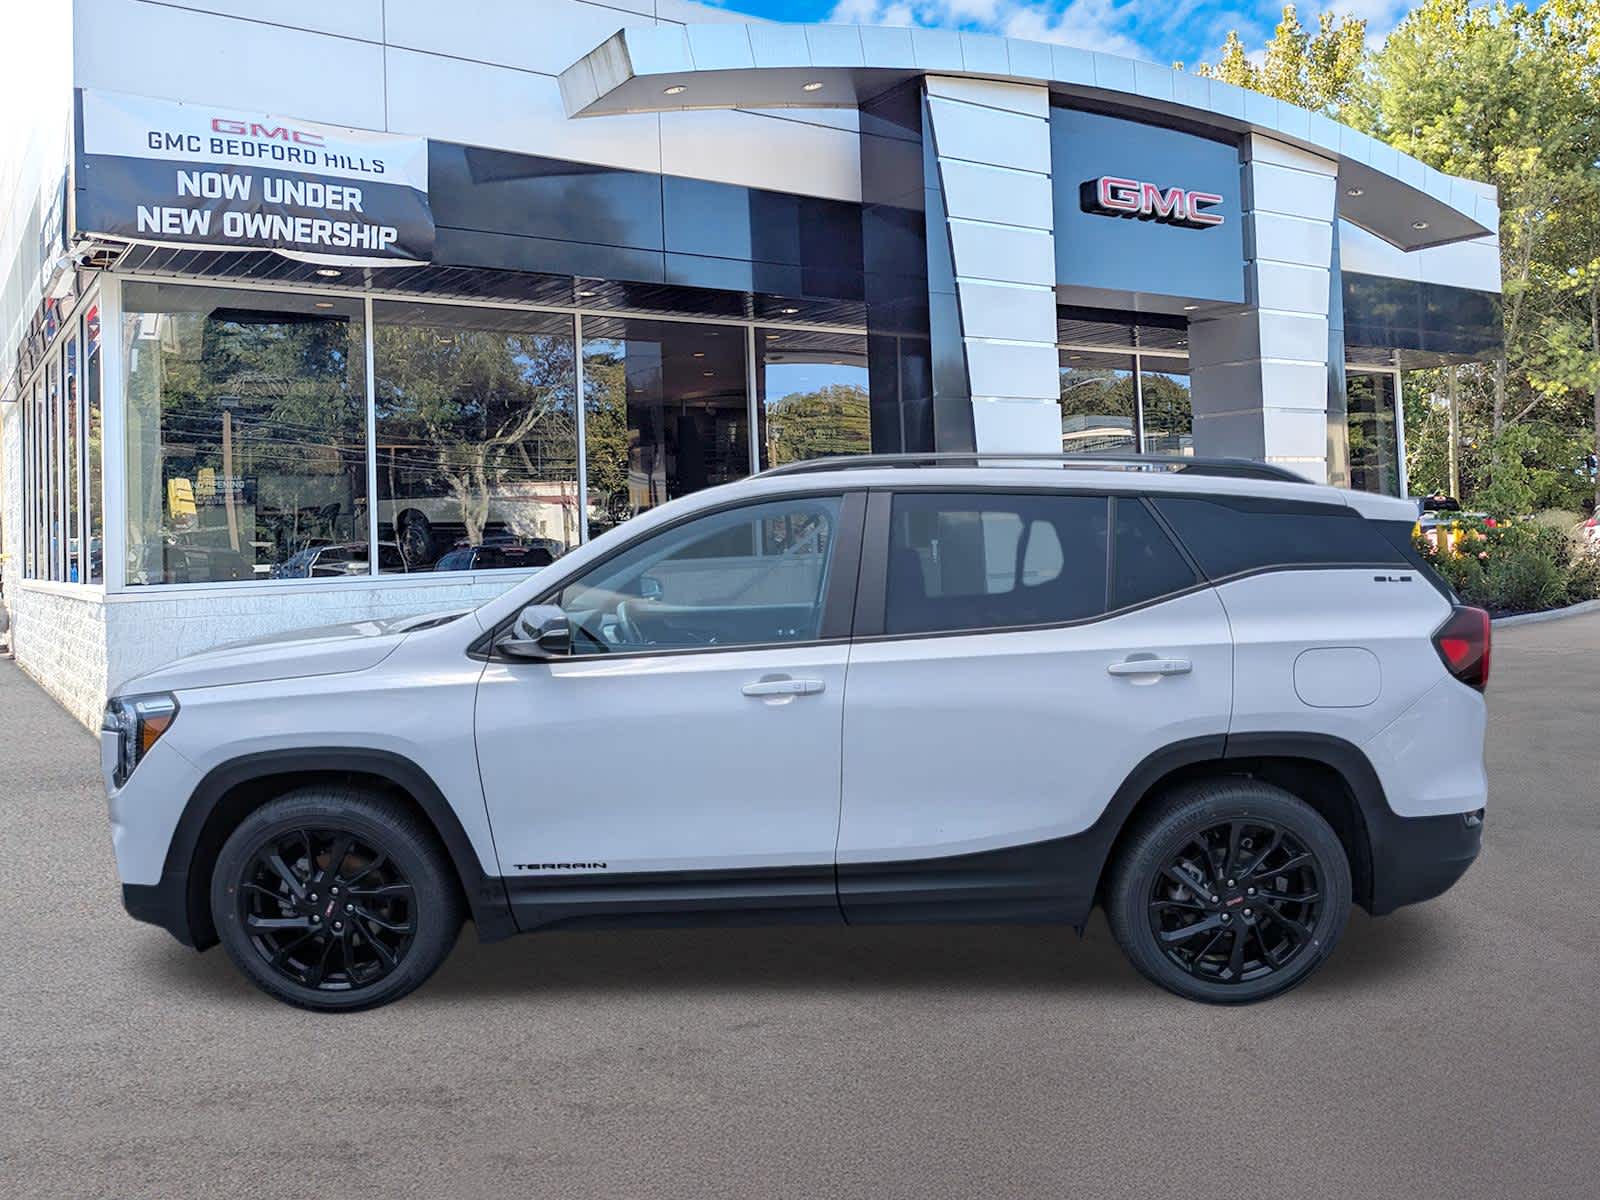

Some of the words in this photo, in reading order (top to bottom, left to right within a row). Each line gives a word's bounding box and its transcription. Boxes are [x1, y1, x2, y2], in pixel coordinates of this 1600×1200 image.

[148, 131, 201, 152] GMC
[210, 138, 316, 165] BEDFORD
[324, 152, 385, 174] HILLS
[211, 118, 325, 147] GMC
[177, 170, 252, 201] NOW
[264, 177, 363, 213] UNDER
[1098, 176, 1225, 224] GMC
[137, 205, 211, 236] NEW
[223, 211, 398, 250] OWNERSHIP
[513, 862, 607, 870] TERRAIN
